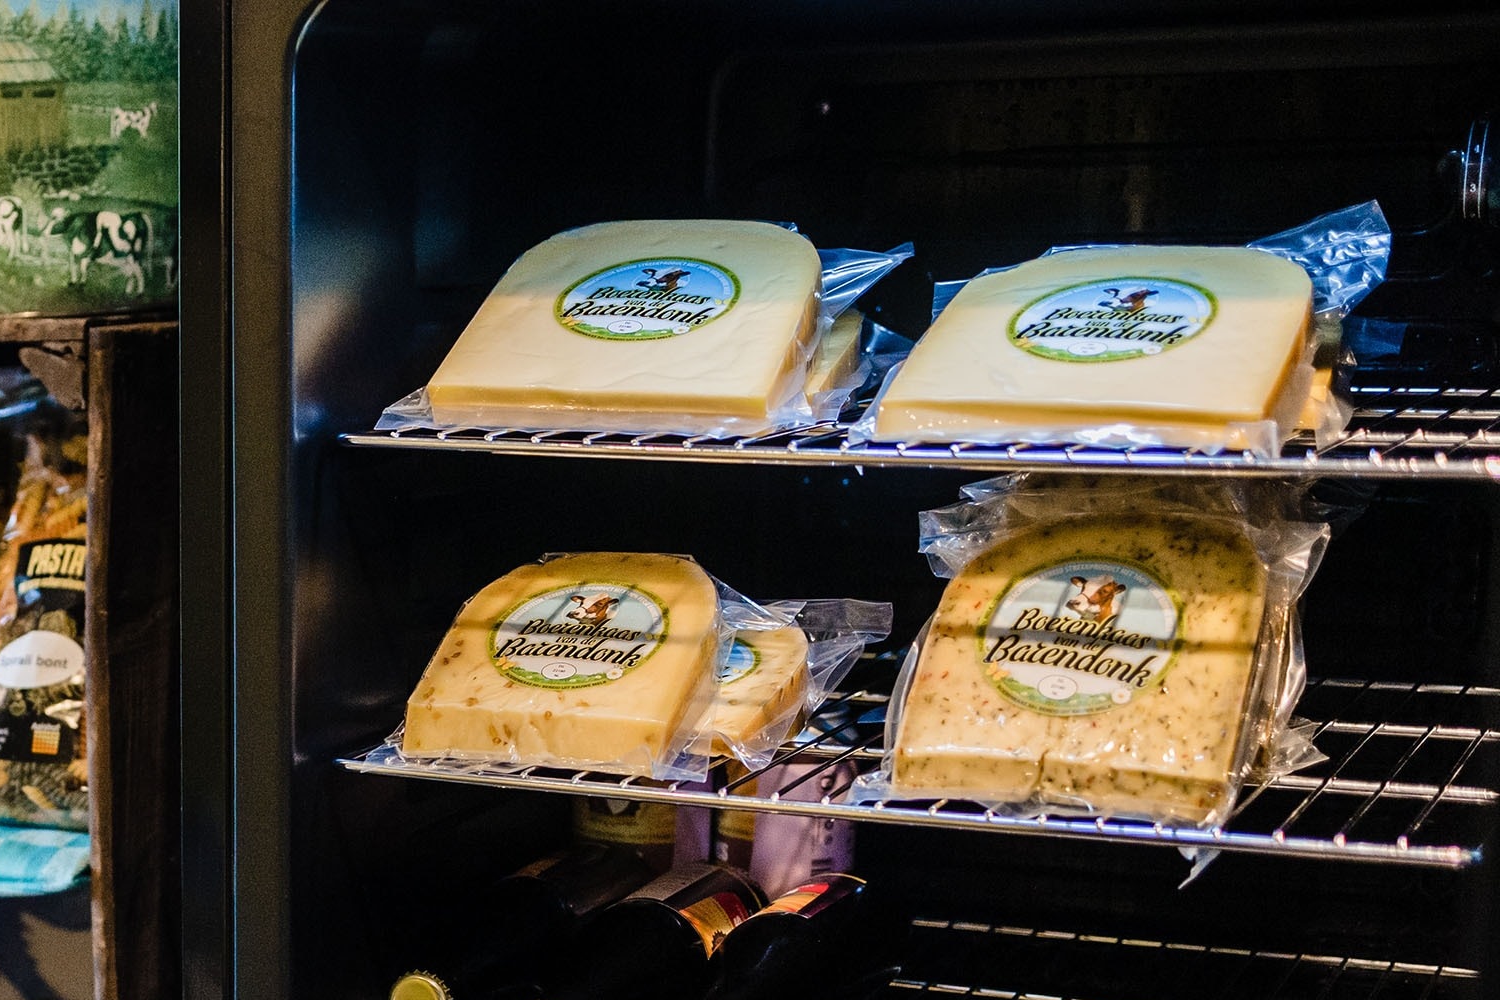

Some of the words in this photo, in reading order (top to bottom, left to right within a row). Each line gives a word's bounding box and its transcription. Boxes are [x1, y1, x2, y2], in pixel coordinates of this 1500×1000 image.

[587, 286, 715, 305] Boerenkaas
[623, 299, 645, 307] van
[648, 299, 664, 308] de
[560, 300, 717, 325] Barendonk
[1042, 307, 1183, 324] Boerenkaas
[1013, 321, 1189, 344] Barendonk
[1085, 320, 1110, 328] van
[27, 544, 86, 577] PASTA
[518, 618, 642, 642] Boerenkaas
[1011, 607, 1151, 650] Boerenkaas
[555, 636, 578, 644] van
[579, 636, 597, 646] de
[1053, 636, 1080, 648] van
[1082, 640, 1102, 651] de
[36, 655, 68, 669] bont
[492, 637, 647, 667] Barendonk
[983, 634, 1158, 688] Barendonk
